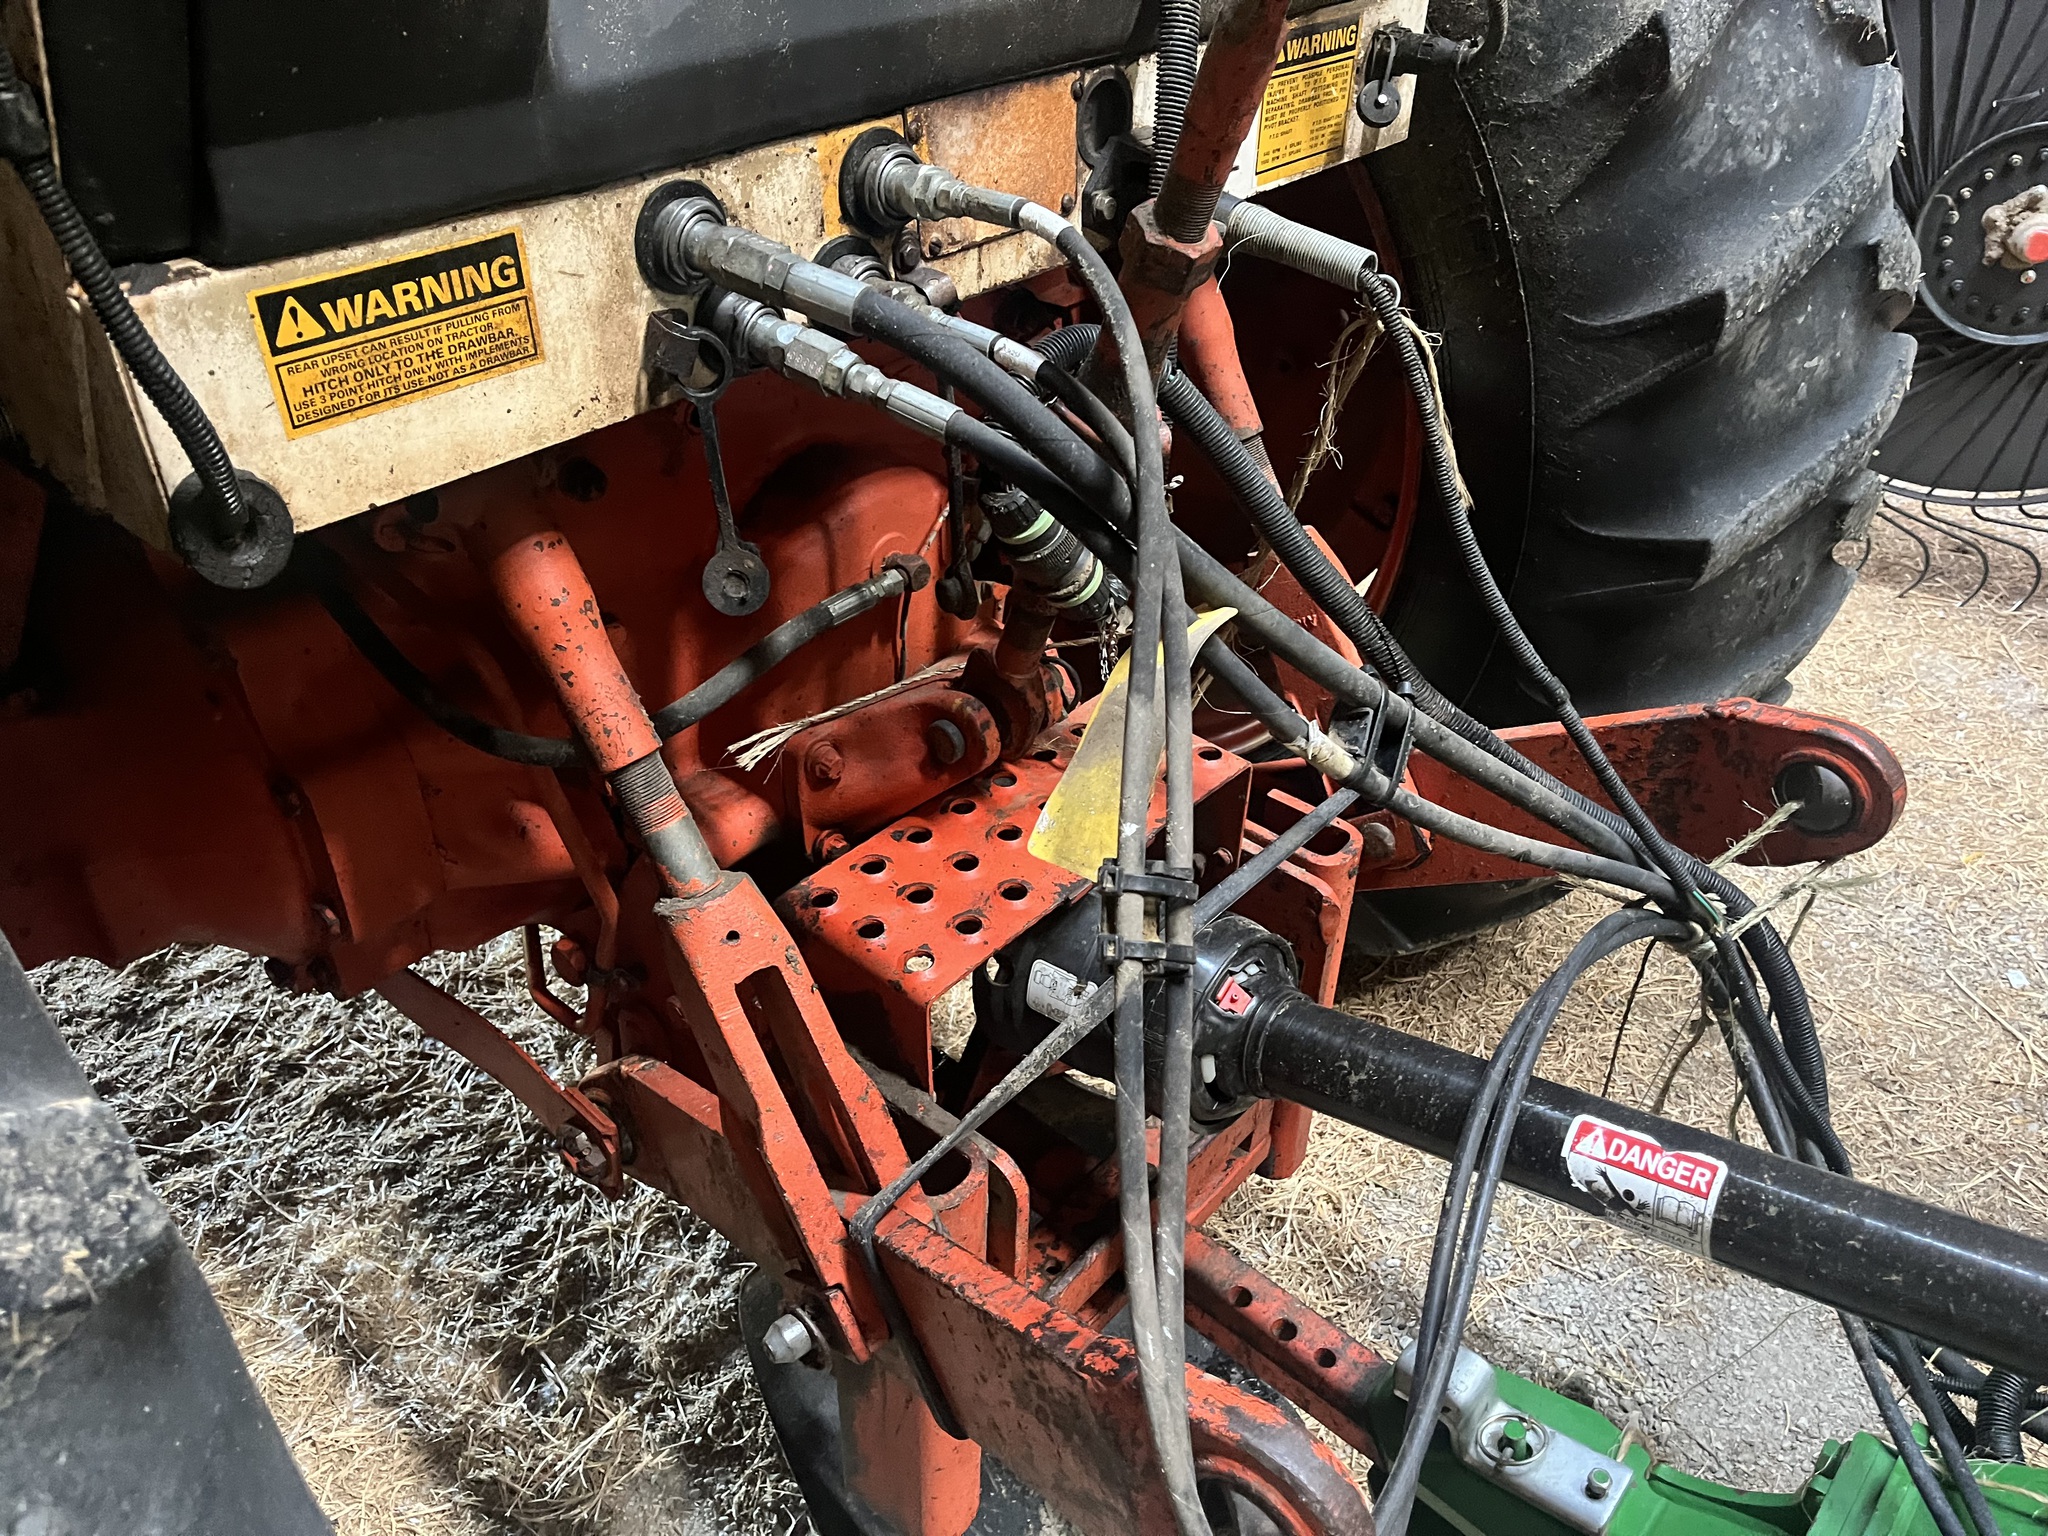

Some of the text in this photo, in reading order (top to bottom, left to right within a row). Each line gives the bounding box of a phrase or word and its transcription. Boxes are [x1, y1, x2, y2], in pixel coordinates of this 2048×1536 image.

[1286, 24, 1358, 62] WARNING
[1277, 76, 1298, 87] PREVENT
[1289, 84, 1299, 92] DUE
[1292, 89, 1306, 99] SHAFT
[320, 254, 518, 333] WARNING
[286, 303, 520, 375] REAR UPSET CAN RESULT IF PULLING FROM
[302, 326, 518, 397] HITCH ONLY TO THE DRAWBAR.
[320, 358, 365, 378] WRONG
[367, 341, 424, 364] LOCATION
[426, 336, 443, 348] ON
[293, 397, 317, 412] USE
[318, 394, 327, 404] 3
[328, 383, 364, 401] POINT
[366, 372, 402, 390] HITCH
[403, 363, 433, 379] ONLY
[434, 354, 462, 370] WITH
[464, 334, 529, 361] IMPLEMENTS
[295, 397, 356, 423] DESIGNED
[358, 390, 381, 404] FOR
[383, 384, 400, 396] ITS
[451, 364, 466, 376] AS
[468, 361, 476, 370] A
[478, 345, 531, 367] DRAWBAR.
[1606, 1138, 1712, 1193] DANGER
